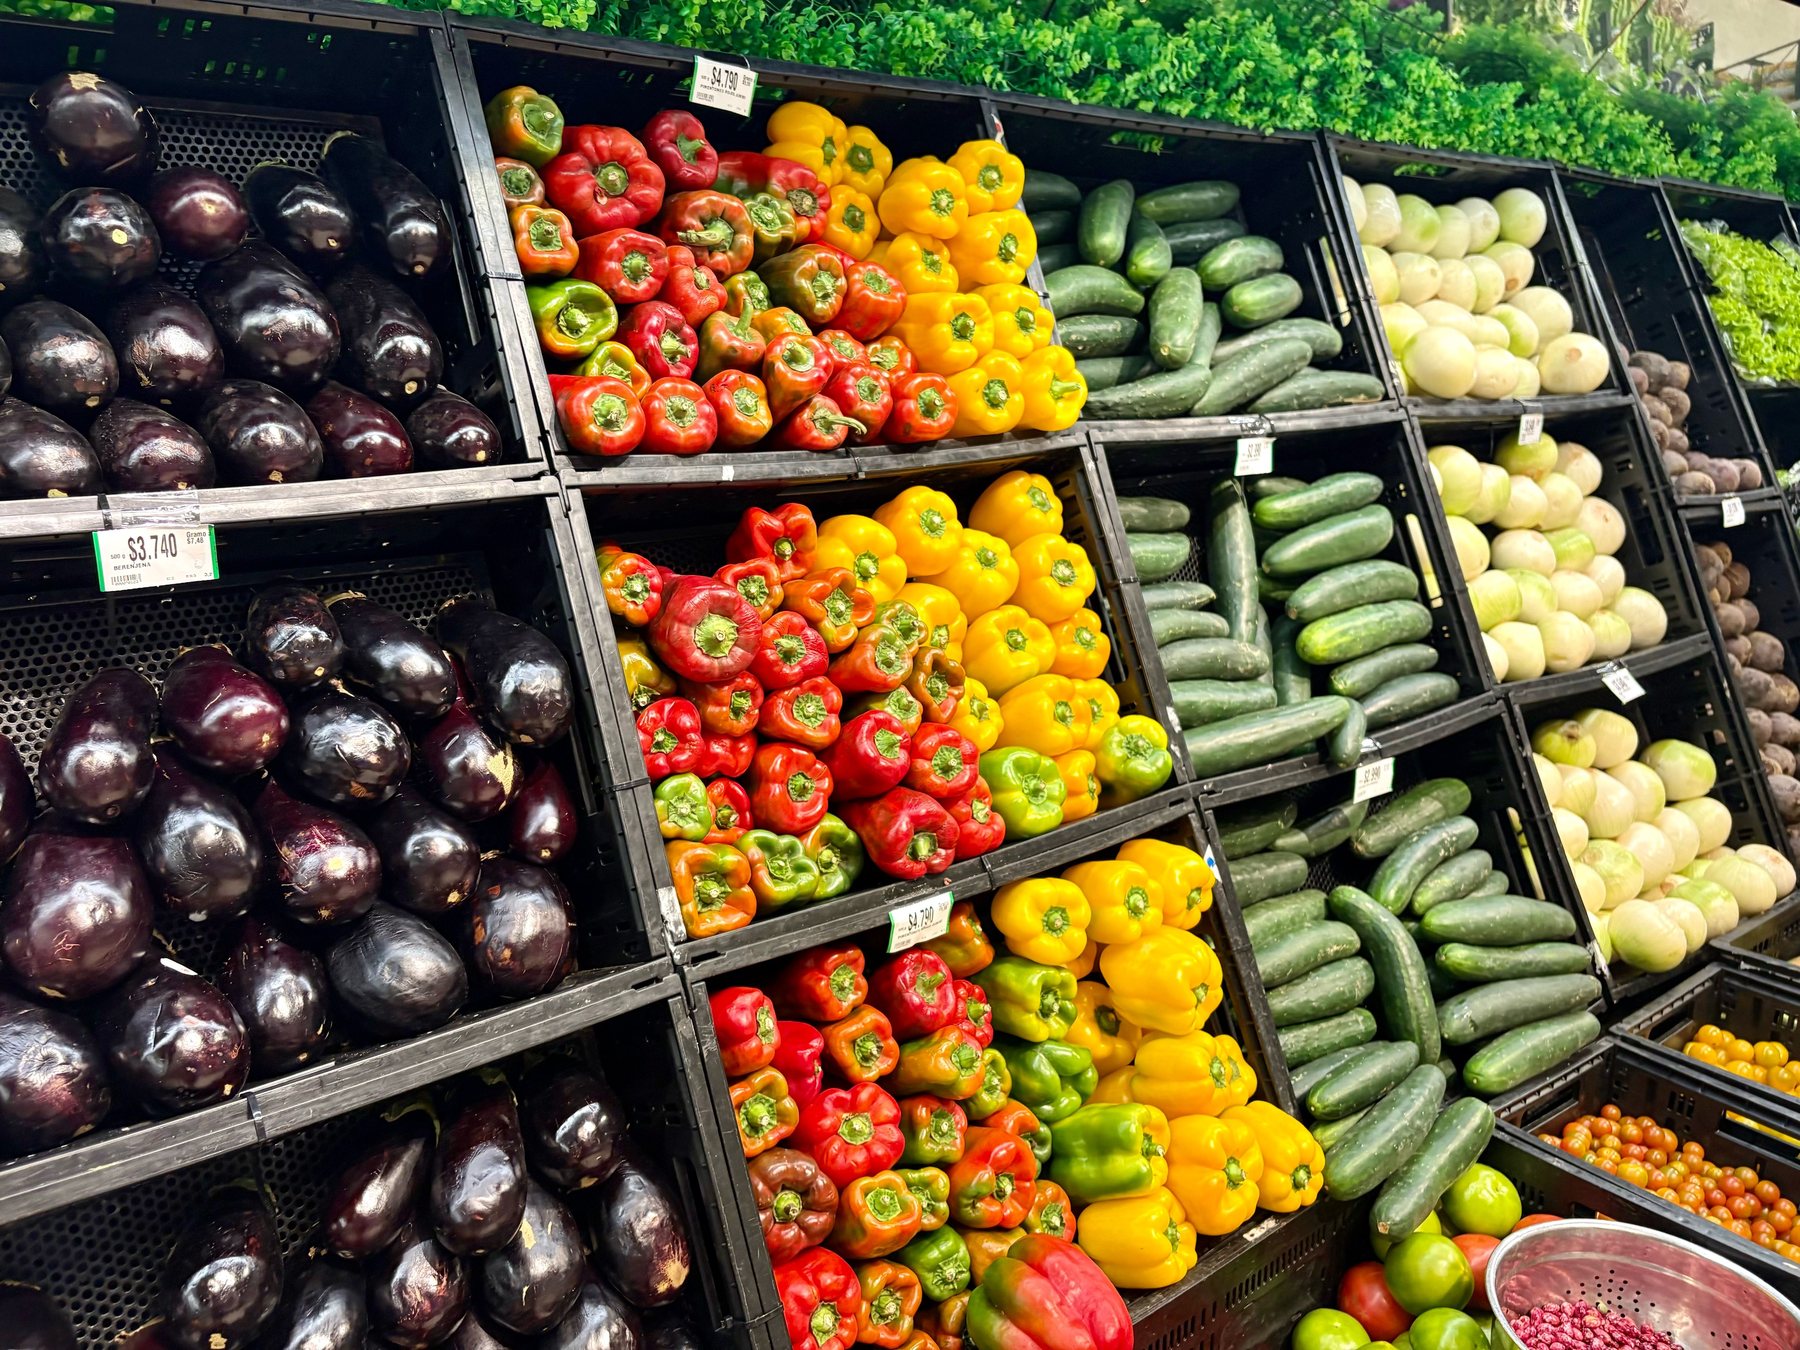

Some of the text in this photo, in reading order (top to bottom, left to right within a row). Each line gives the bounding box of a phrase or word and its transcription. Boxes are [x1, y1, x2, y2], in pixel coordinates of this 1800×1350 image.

[711, 66, 738, 91] $4.790
[127, 533, 177, 561] $3.740
[113, 562, 151, 571] BERENJENA
[908, 906, 934, 931] $4.790
